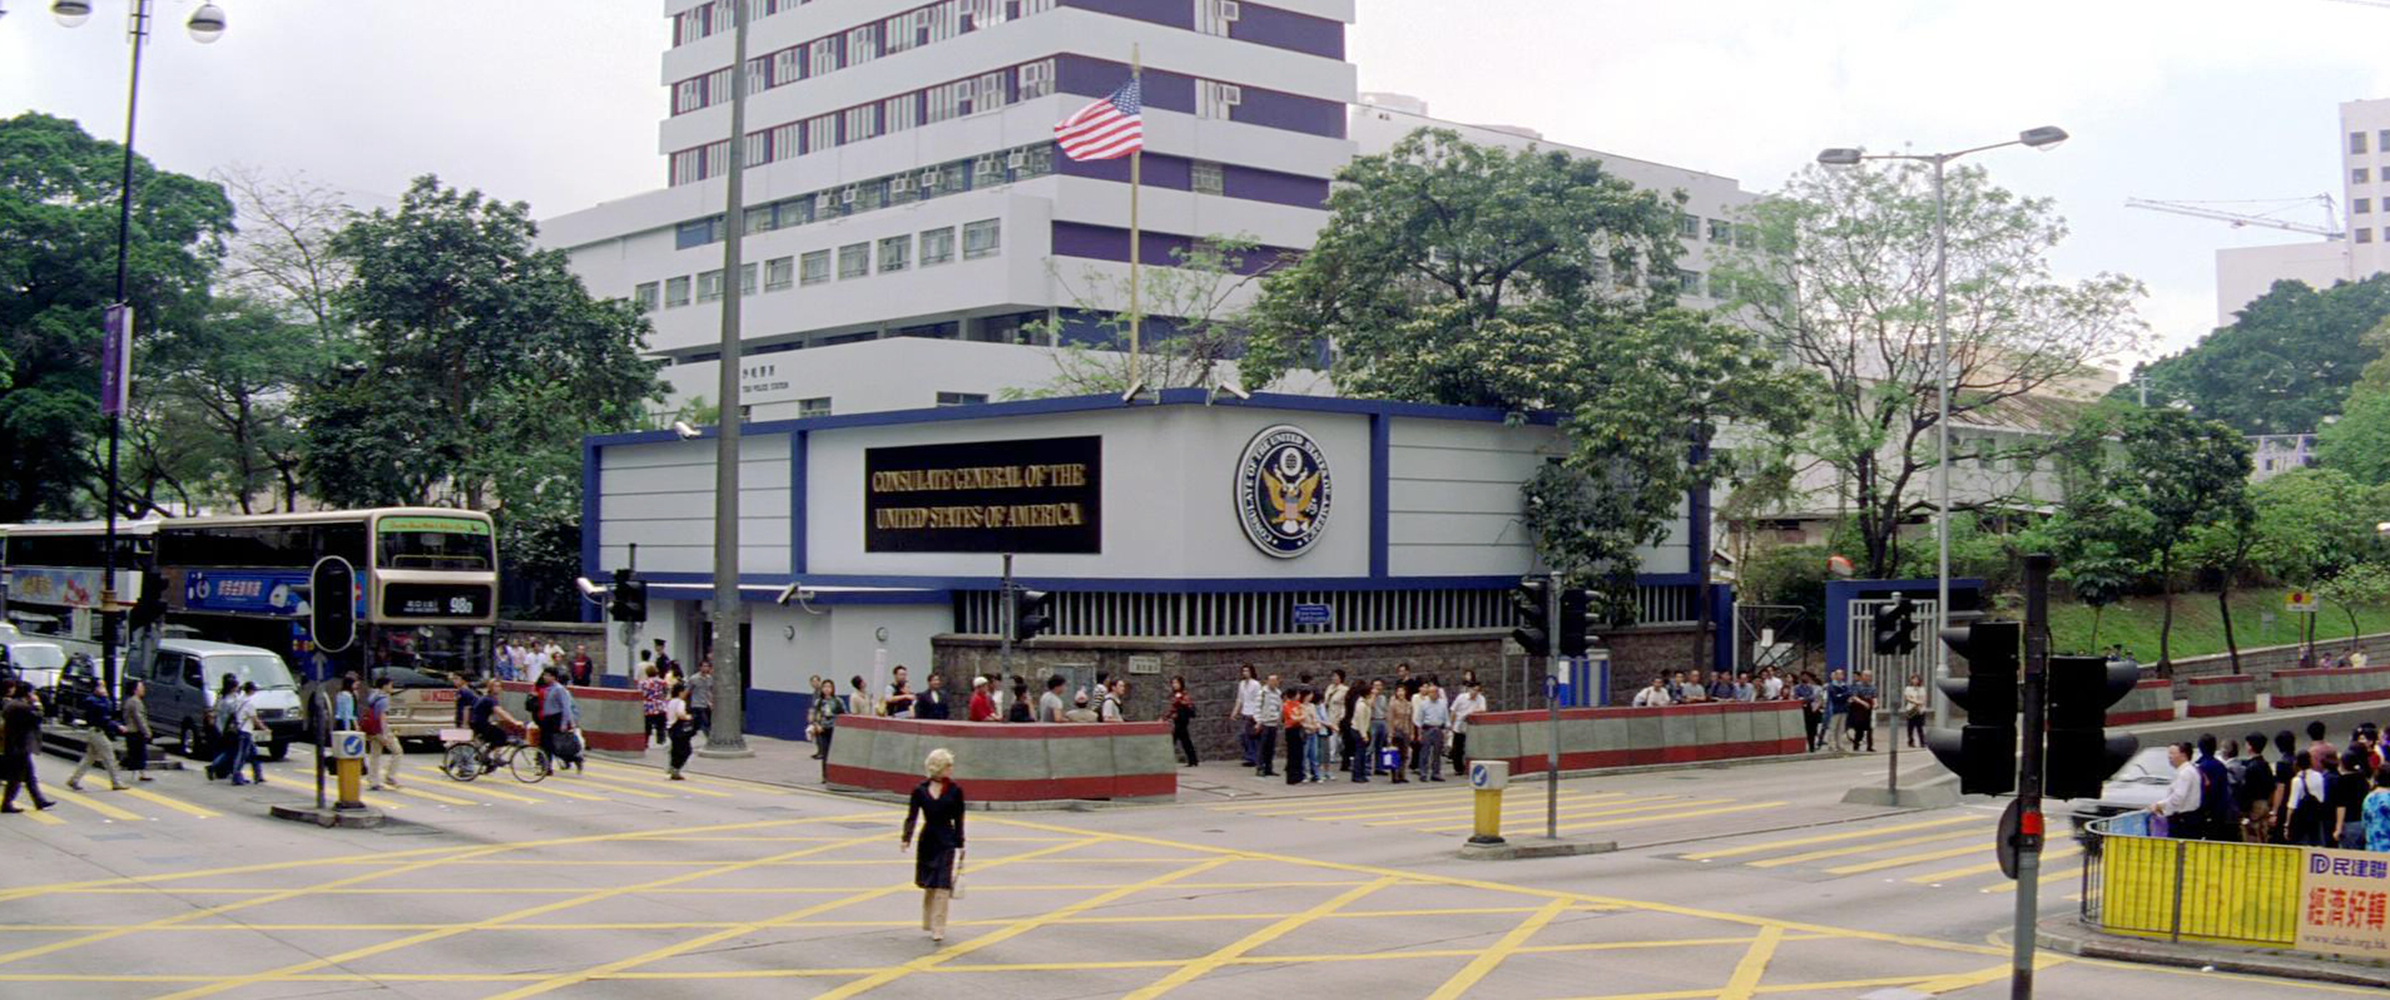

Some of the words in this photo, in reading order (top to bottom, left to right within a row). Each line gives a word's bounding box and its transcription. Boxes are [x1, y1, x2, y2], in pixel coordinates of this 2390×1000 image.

[753, 383, 769, 392] POLICE
[770, 381, 790, 390] STATION
[1254, 442, 1272, 460] THE
[1270, 434, 1304, 445] UNITED
[1303, 440, 1329, 475] STATES
[872, 469, 951, 492] CONSULATE
[954, 466, 1023, 490] GENERAL
[1025, 465, 1047, 488] OF
[1050, 463, 1086, 487] THE
[875, 506, 928, 529] UNITED
[930, 505, 984, 528] STATES
[984, 505, 1007, 528] OF
[1007, 502, 1083, 527] AMERICA
[2333, 858, 2388, 879] 民建聯
[2307, 887, 2387, 932] 經濟好轉
